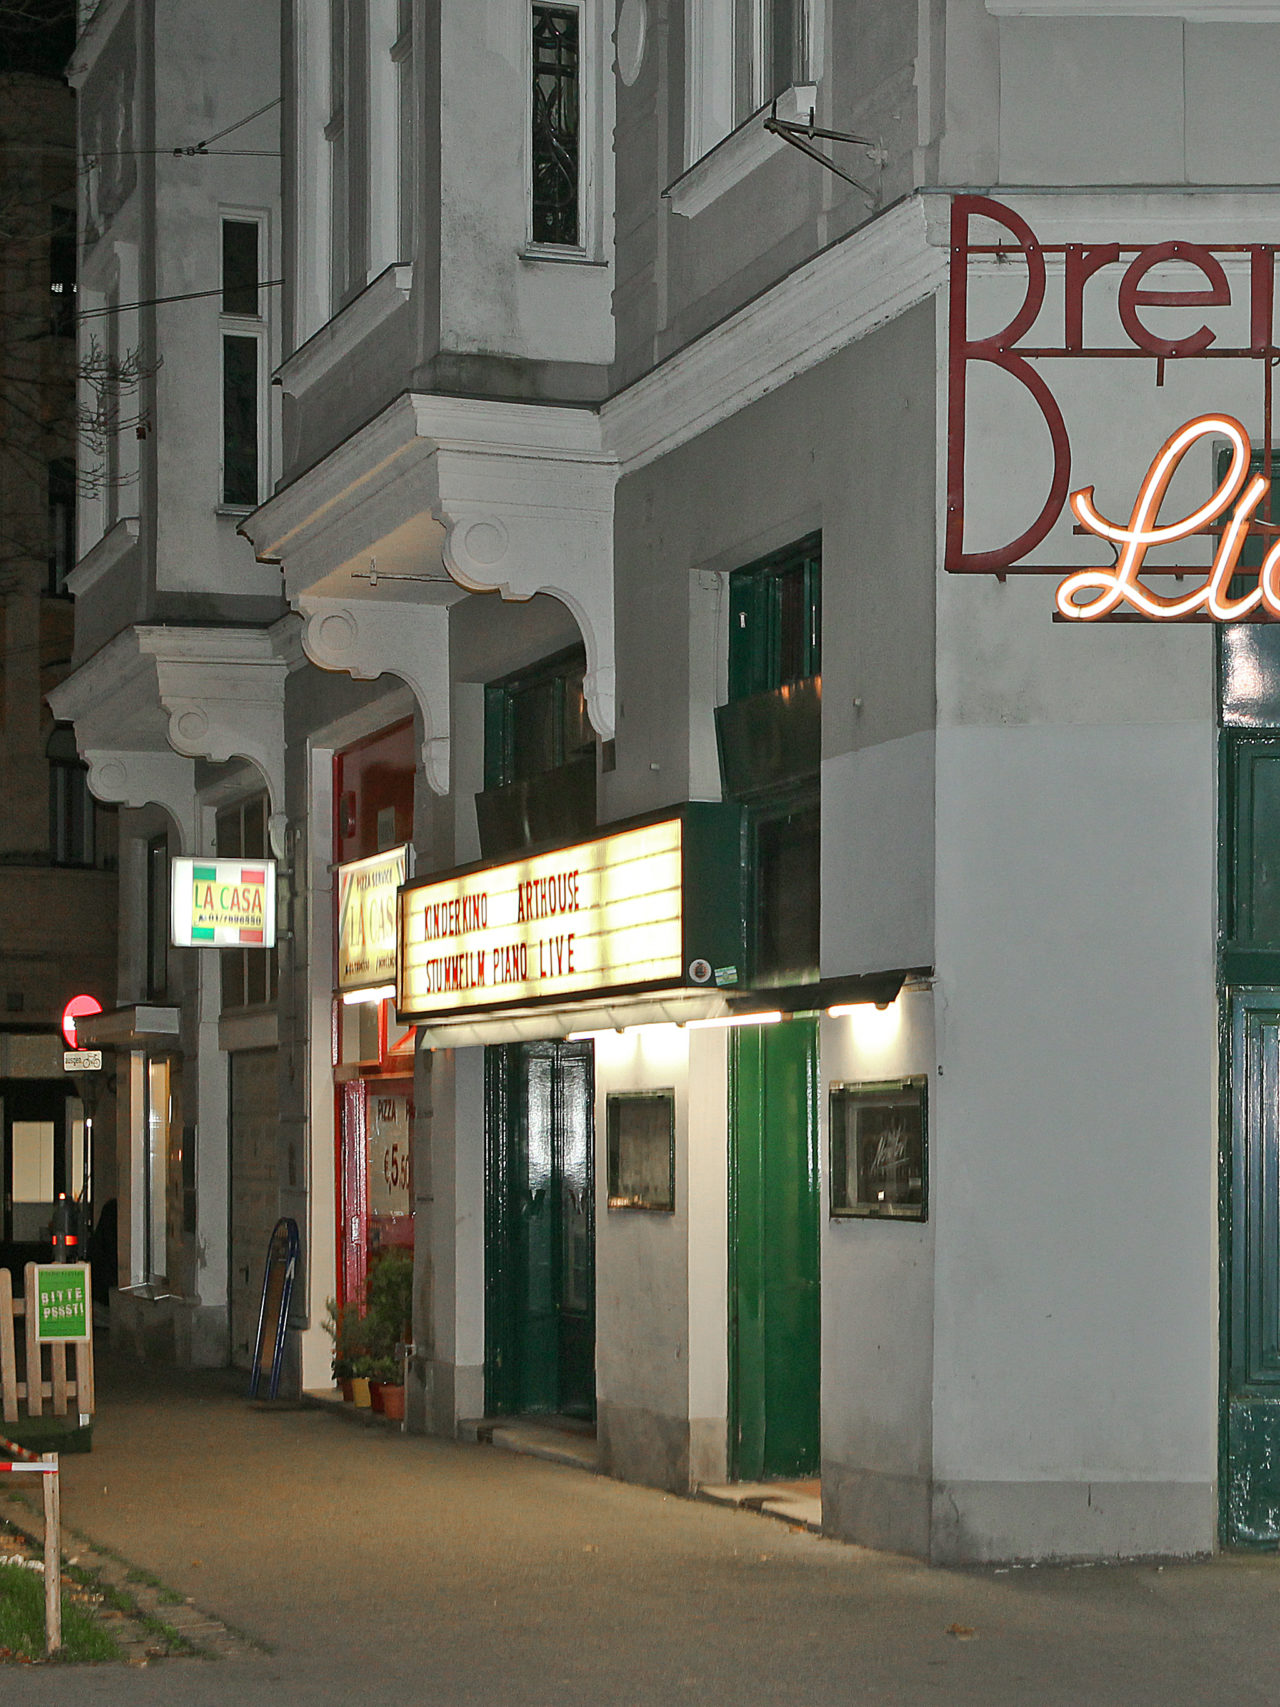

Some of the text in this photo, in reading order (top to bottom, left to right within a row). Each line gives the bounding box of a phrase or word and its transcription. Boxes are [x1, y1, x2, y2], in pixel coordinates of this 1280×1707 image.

[195, 885, 262, 913] LA CASA
[424, 870, 580, 942] KINDERKINO ARTHOUSE
[369, 895, 395, 945] CAS
[426, 950, 485, 994] STUMMFILM
[493, 943, 528, 985] PIANO
[539, 933, 576, 979] LIVE
[378, 1099, 397, 1123] PIZZA
[41, 1287, 83, 1305] BITTE
